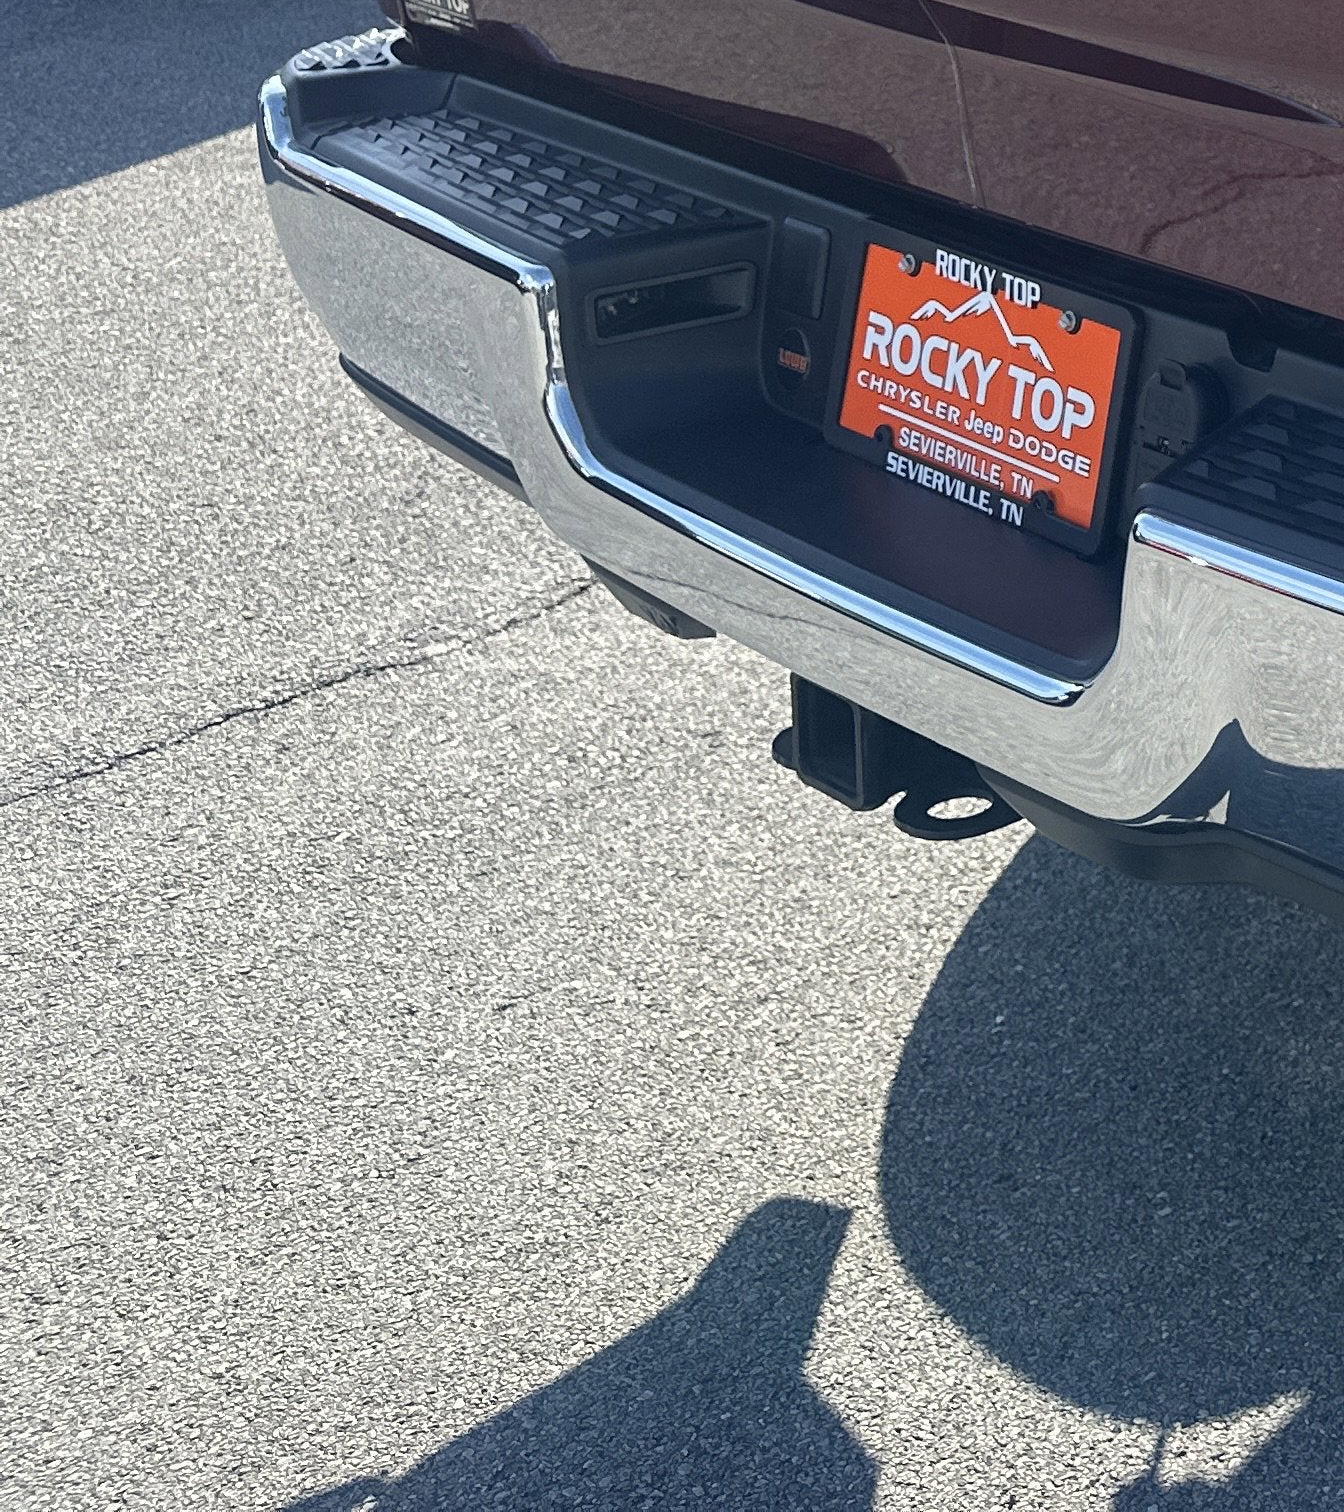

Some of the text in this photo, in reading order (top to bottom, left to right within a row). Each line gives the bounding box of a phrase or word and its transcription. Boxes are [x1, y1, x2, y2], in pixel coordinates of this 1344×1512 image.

[935, 248, 1041, 308] ROCKY TOP
[863, 311, 1095, 439] ROCKY TOP
[856, 370, 1091, 478] CHRYSLER Jeep DODGE
[886, 452, 1023, 527] SEVIERVILLE, TN
[899, 428, 1034, 500] SEVIERVILLE, TN
